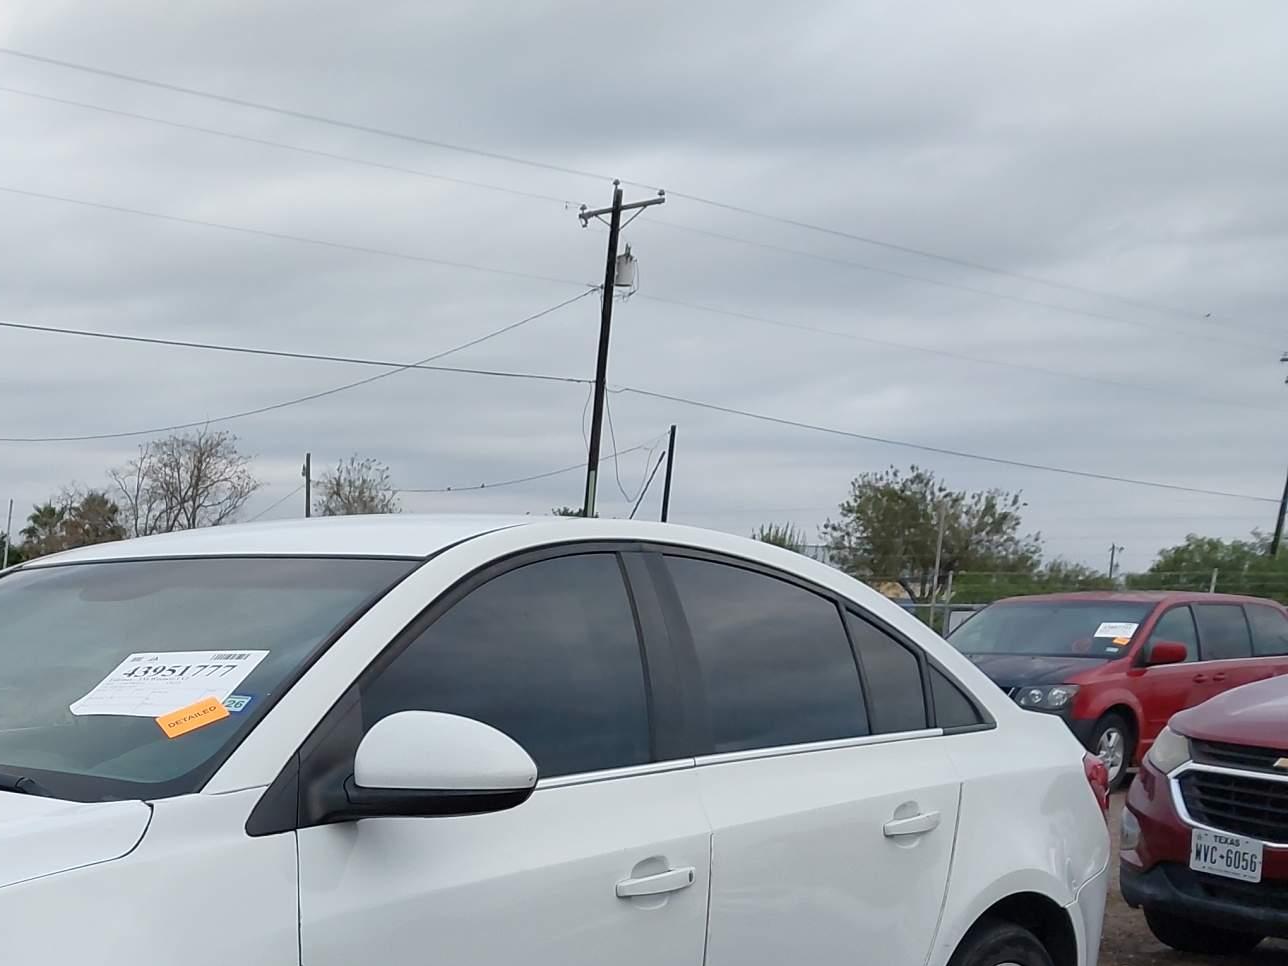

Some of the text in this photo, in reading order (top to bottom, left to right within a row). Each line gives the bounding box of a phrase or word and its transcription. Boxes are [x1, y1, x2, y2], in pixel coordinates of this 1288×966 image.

[122, 664, 236, 677] 43951777
[168, 705, 217, 728] DETAILED
[1213, 835, 1240, 847] TEXAS
